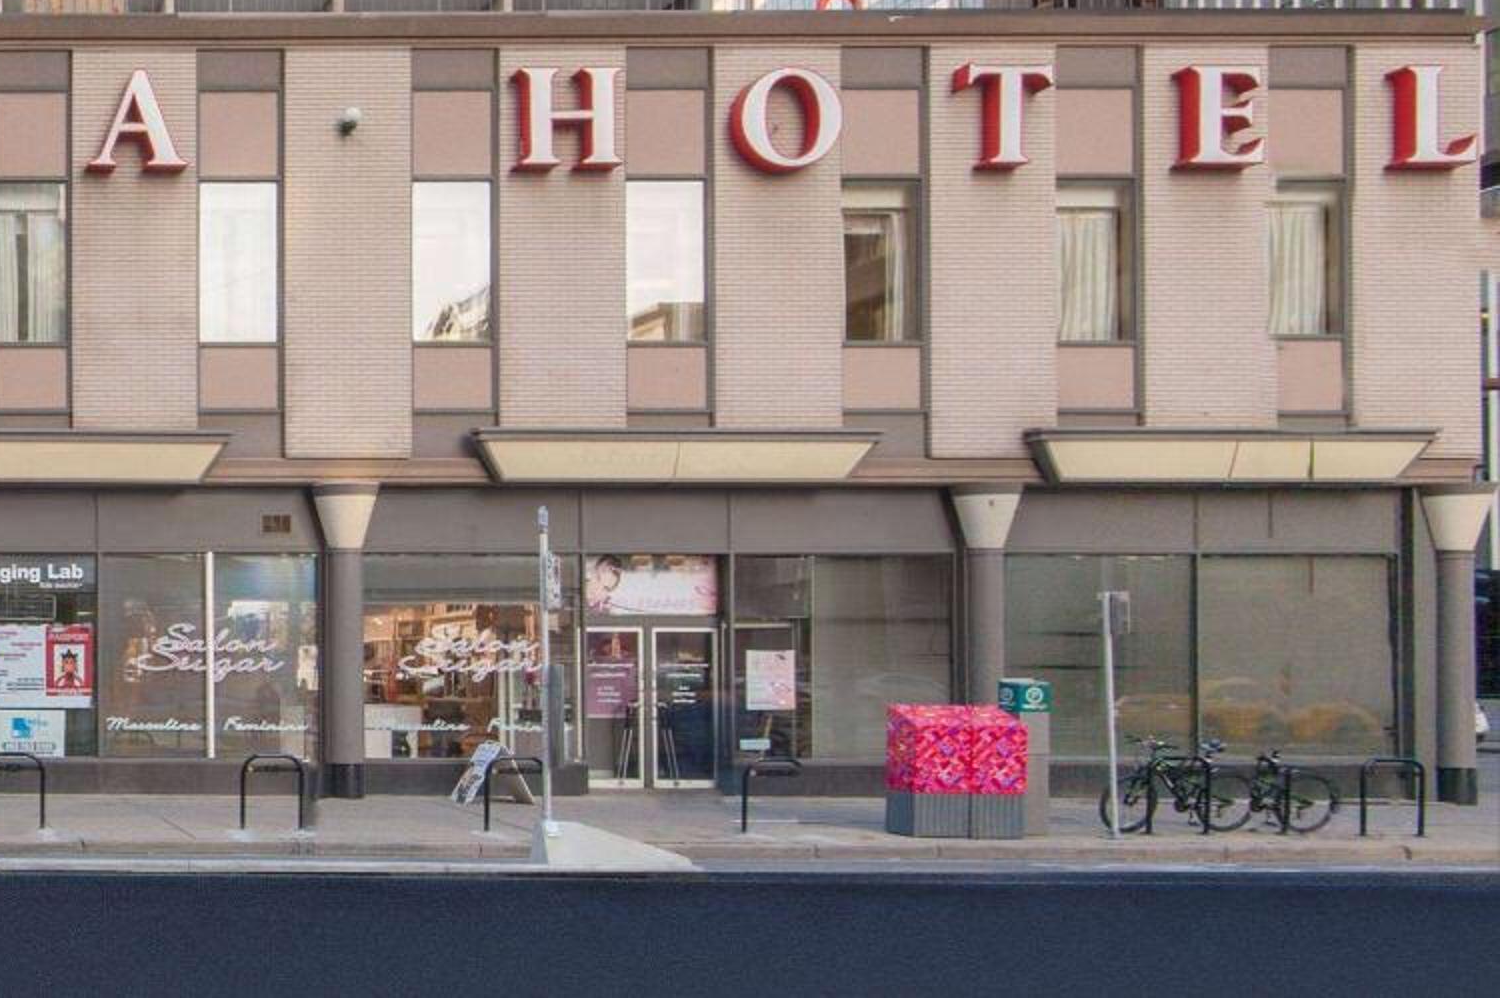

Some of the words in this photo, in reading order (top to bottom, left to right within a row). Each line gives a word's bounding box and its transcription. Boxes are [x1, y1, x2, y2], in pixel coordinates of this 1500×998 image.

[510, 64, 1477, 174] HOTEL
[47, 563, 84, 579] Lab
[153, 623, 277, 653] Salon
